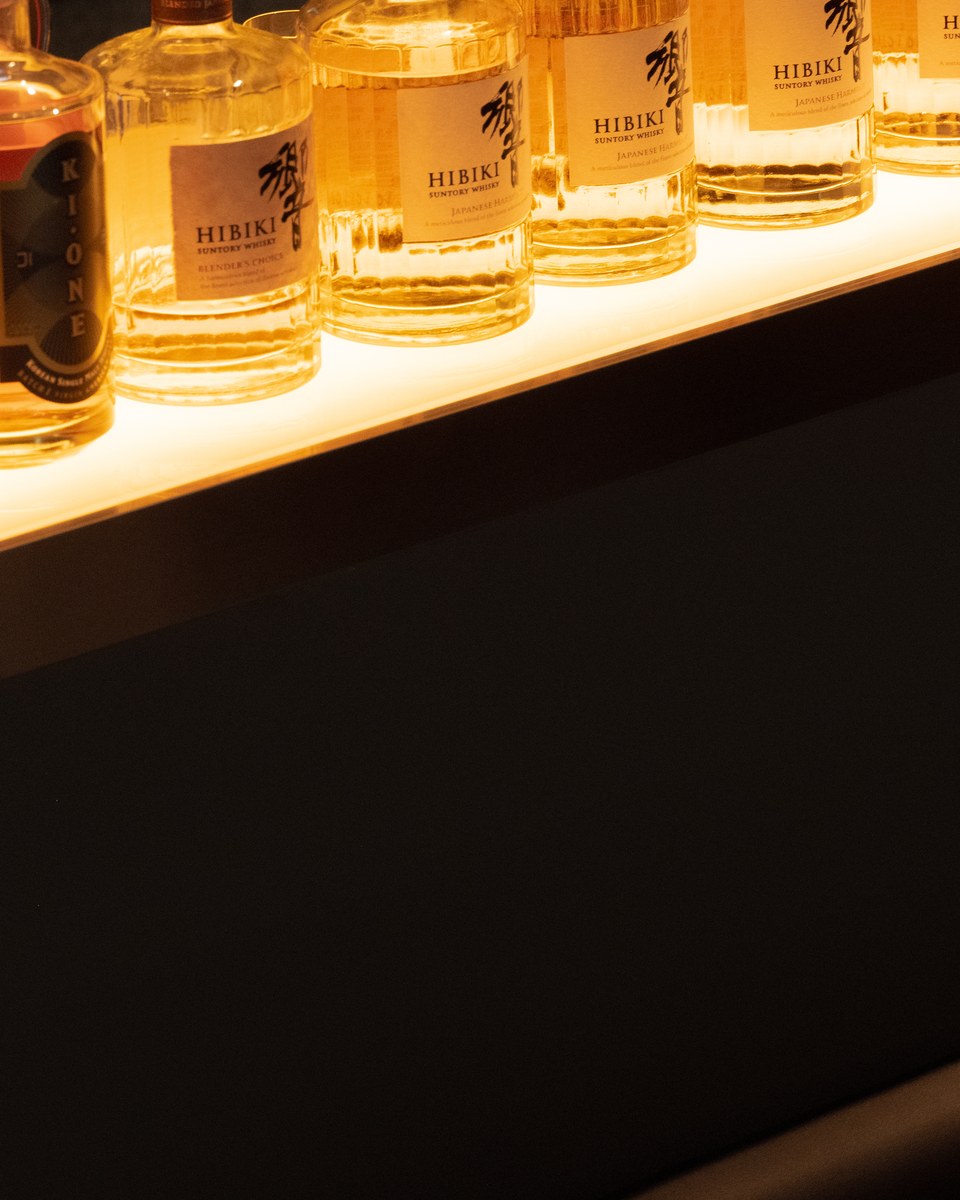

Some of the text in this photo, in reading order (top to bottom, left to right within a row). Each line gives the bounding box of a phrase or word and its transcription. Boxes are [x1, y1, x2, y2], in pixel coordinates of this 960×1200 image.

[773, 56, 843, 80] HIBIKI
[774, 74, 843, 90] SUNTORY WHISKY
[593, 109, 665, 134] HIBIKI
[595, 128, 665, 144] SUNTORY WHISKY
[428, 162, 500, 187] HIBIKI
[429, 181, 500, 198] SUNTORY WHISKY
[196, 217, 277, 243] HIBIKI
[197, 237, 276, 255] SUNTORY WHISKY
[252, 252, 284, 266] CHOICE
